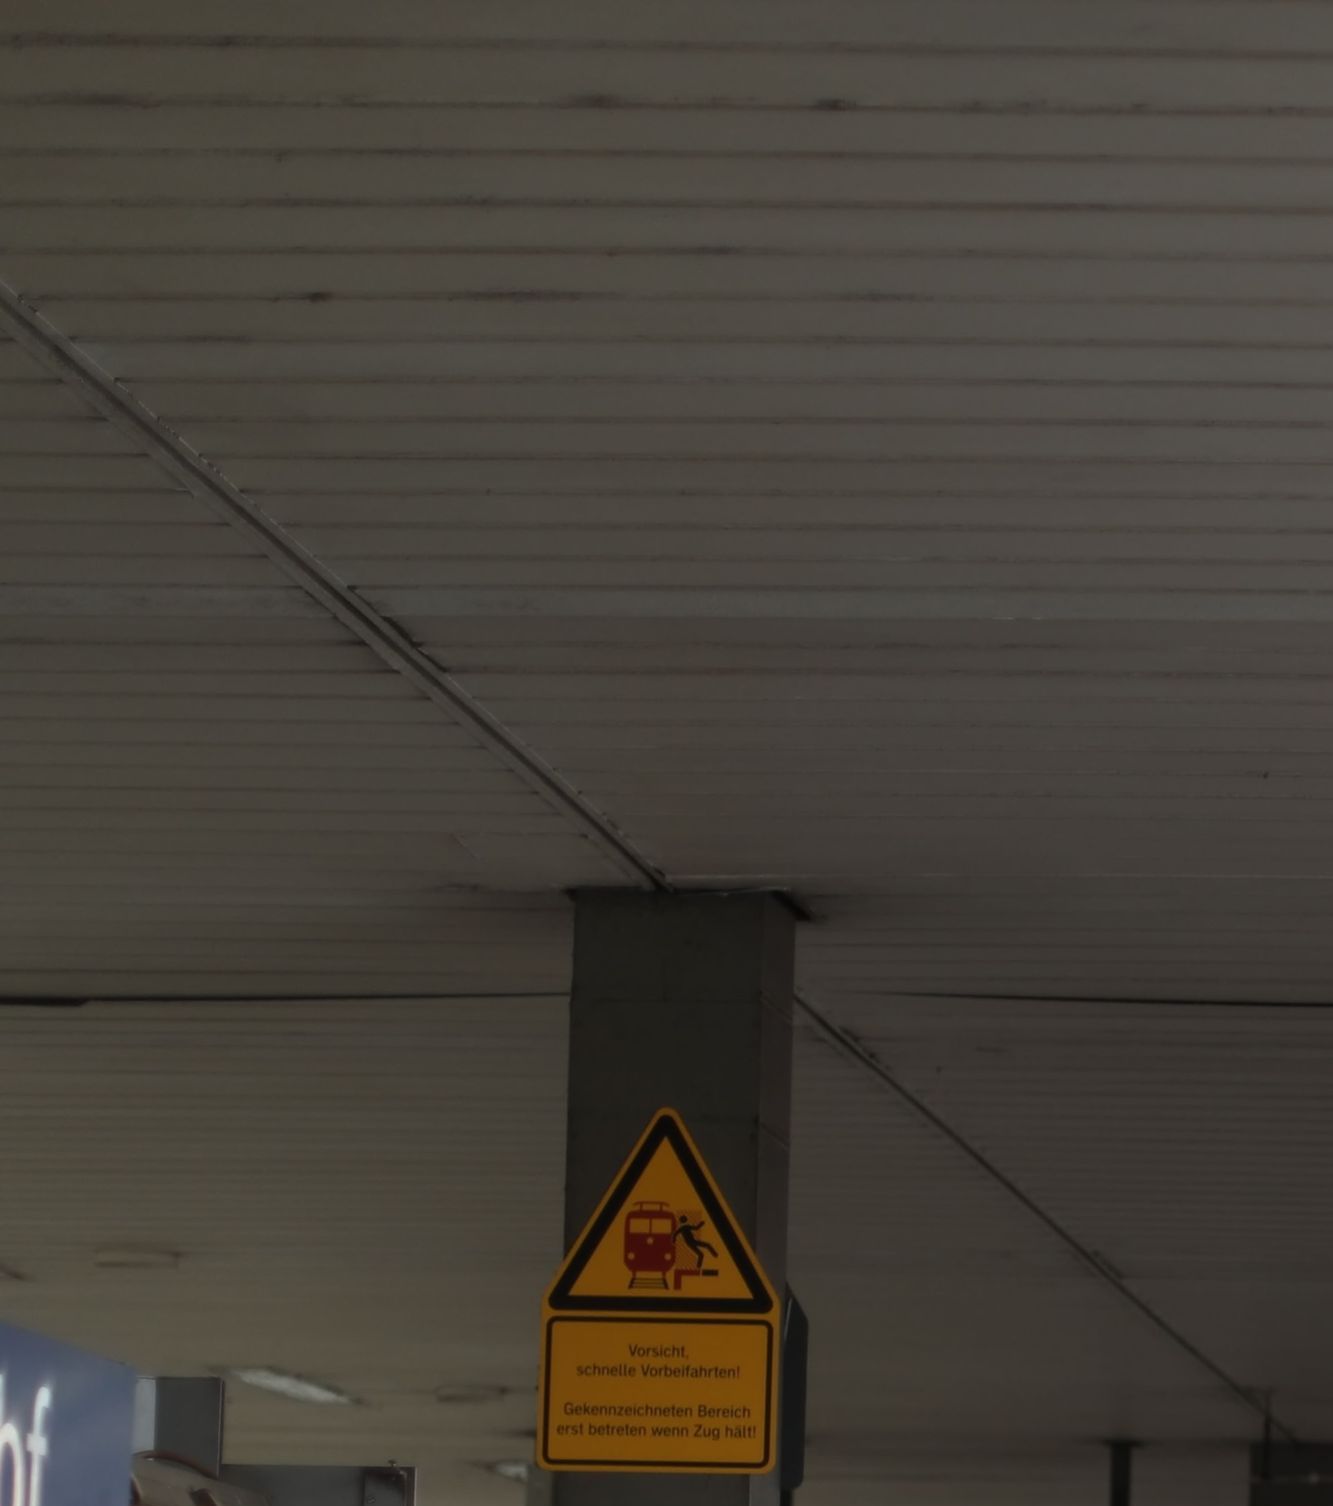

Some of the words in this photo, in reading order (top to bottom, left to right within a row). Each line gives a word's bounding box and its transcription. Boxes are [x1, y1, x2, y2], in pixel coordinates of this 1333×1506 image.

[628, 1344, 688, 1359] Vorsicht,
[576, 1363, 636, 1377] schnelle
[641, 1364, 741, 1379] Vorbeifahrten!
[563, 1402, 693, 1418] Gekennzeichneten
[697, 1404, 751, 1418] Bereich
[556, 1423, 584, 1435] erst
[588, 1423, 647, 1436] betreten
[651, 1426, 689, 1437] wenn
[693, 1424, 721, 1440] Zug
[725, 1424, 757, 1438] hält!
